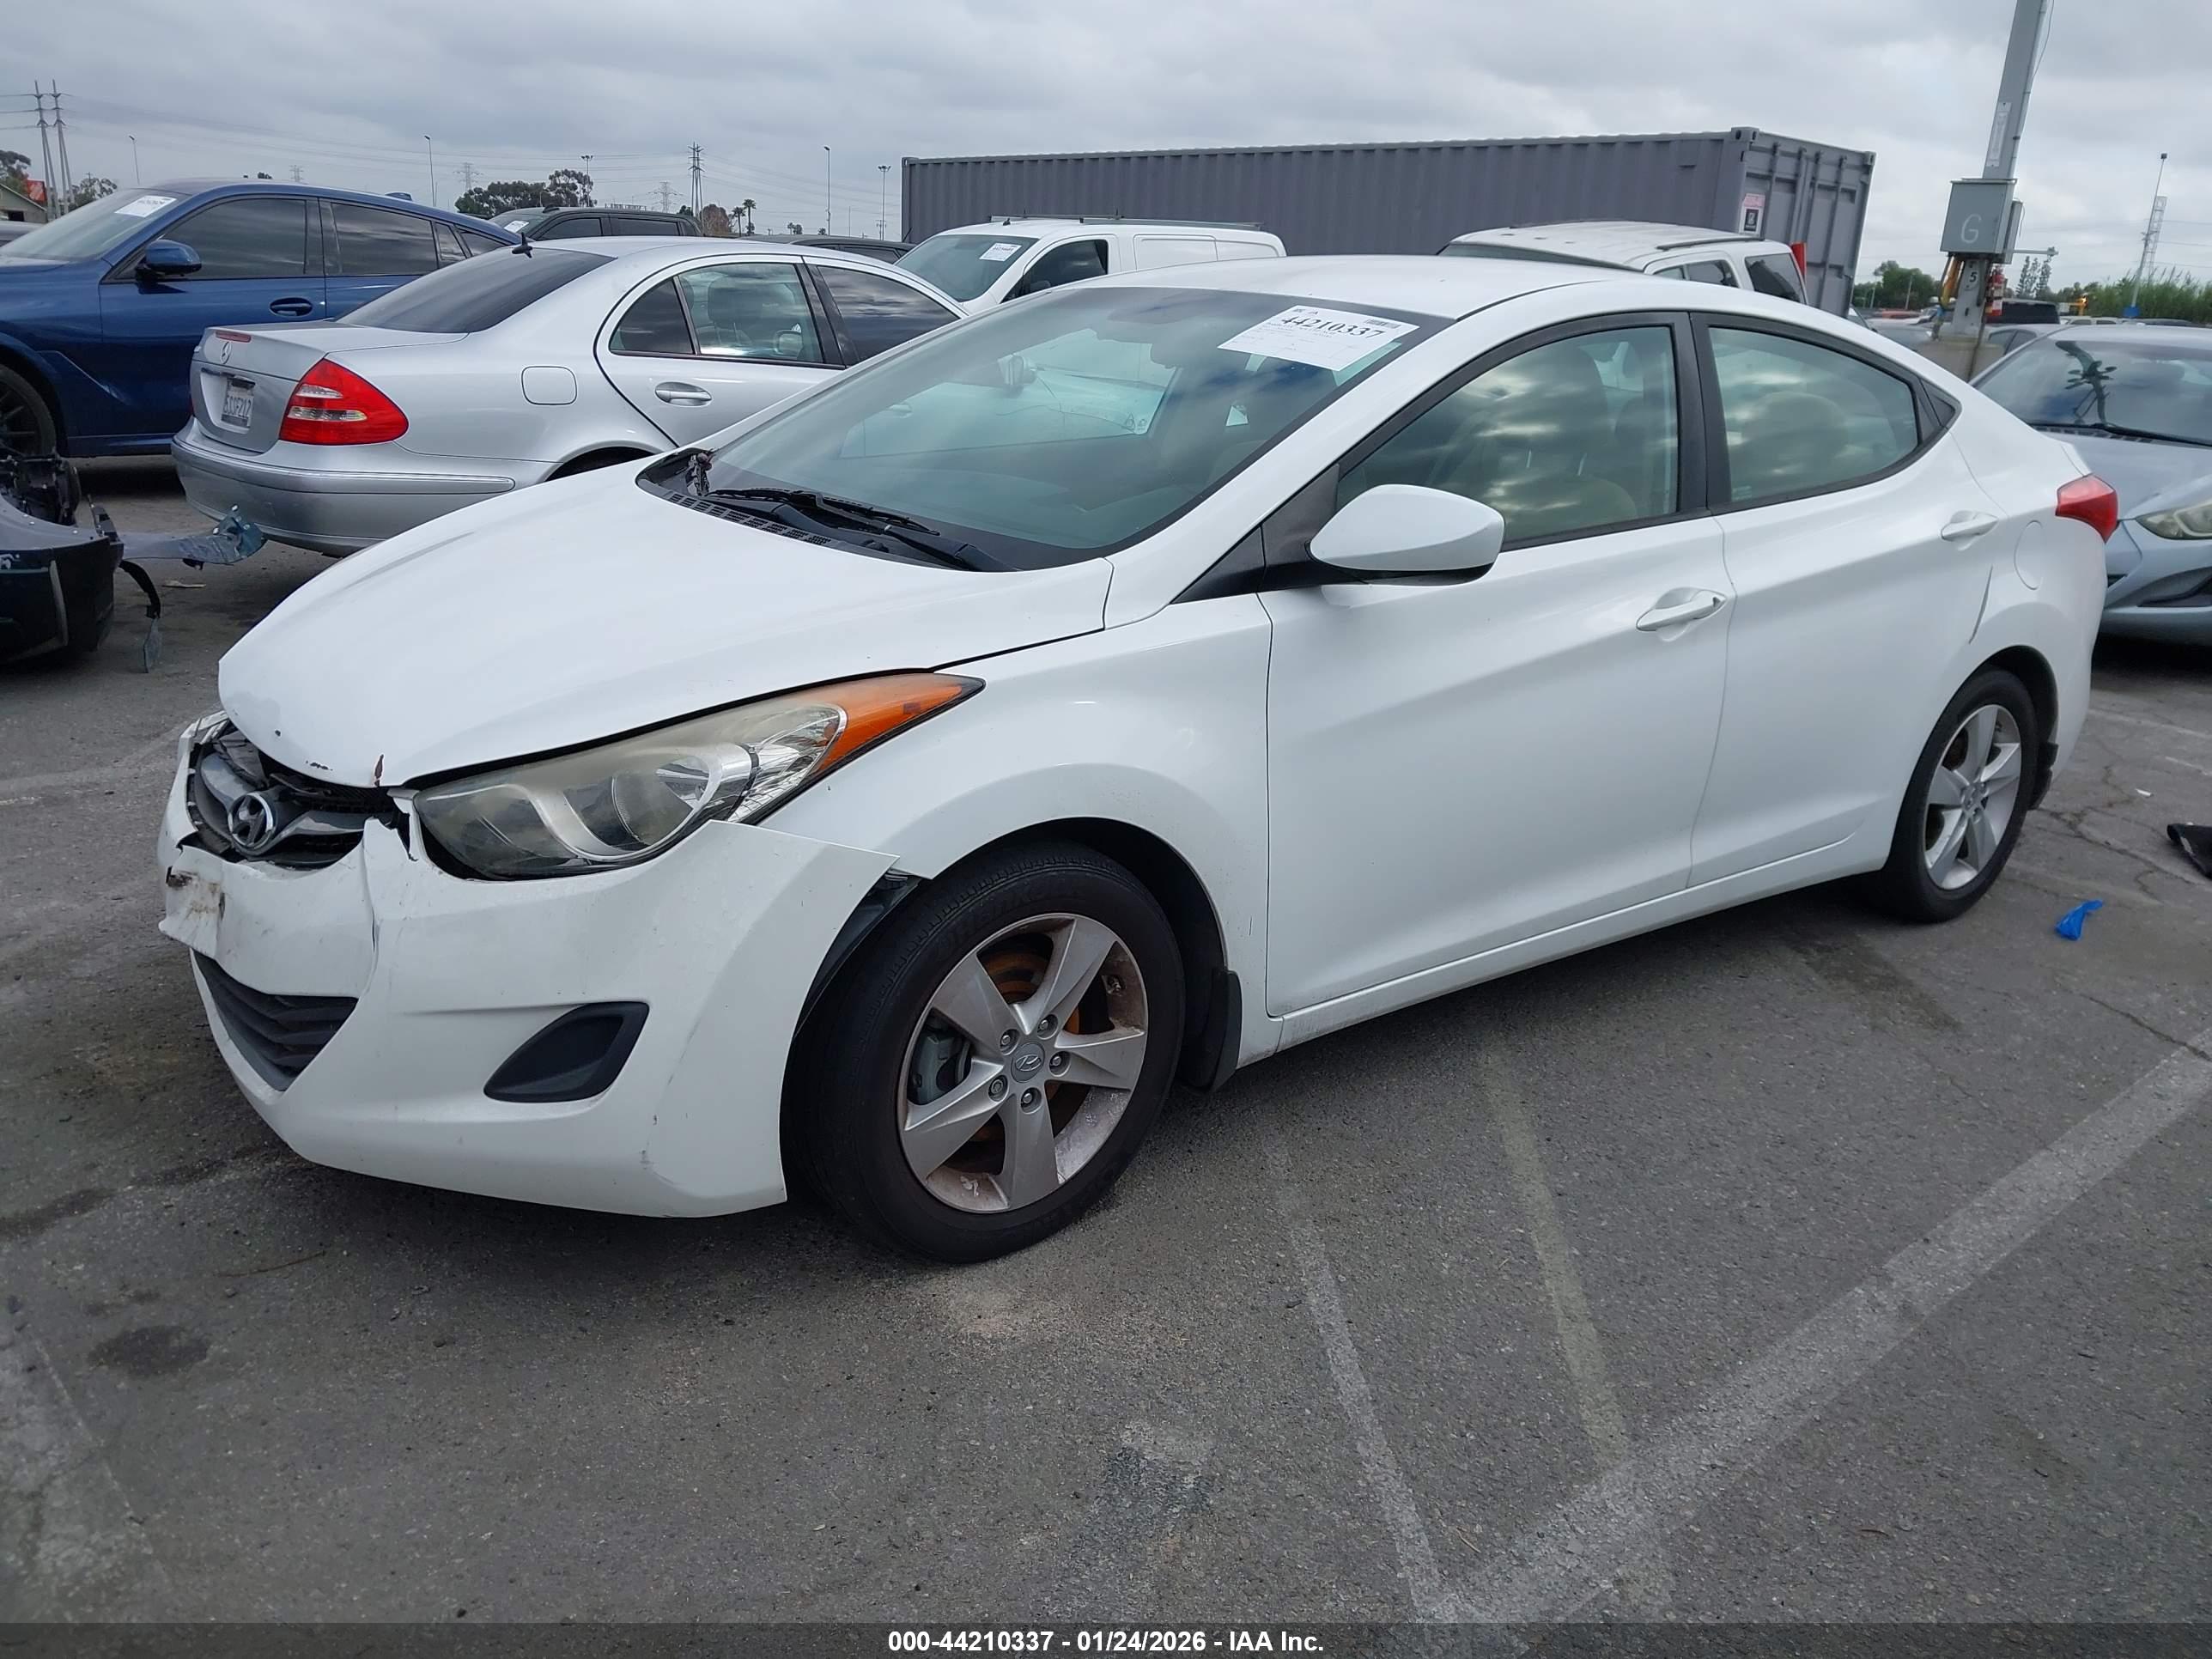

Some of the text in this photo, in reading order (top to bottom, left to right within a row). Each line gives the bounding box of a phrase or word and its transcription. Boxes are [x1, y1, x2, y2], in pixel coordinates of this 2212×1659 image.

[1961, 213, 1982, 244] G
[1969, 271, 1978, 283] 5
[1281, 316, 1386, 338] 44210337
